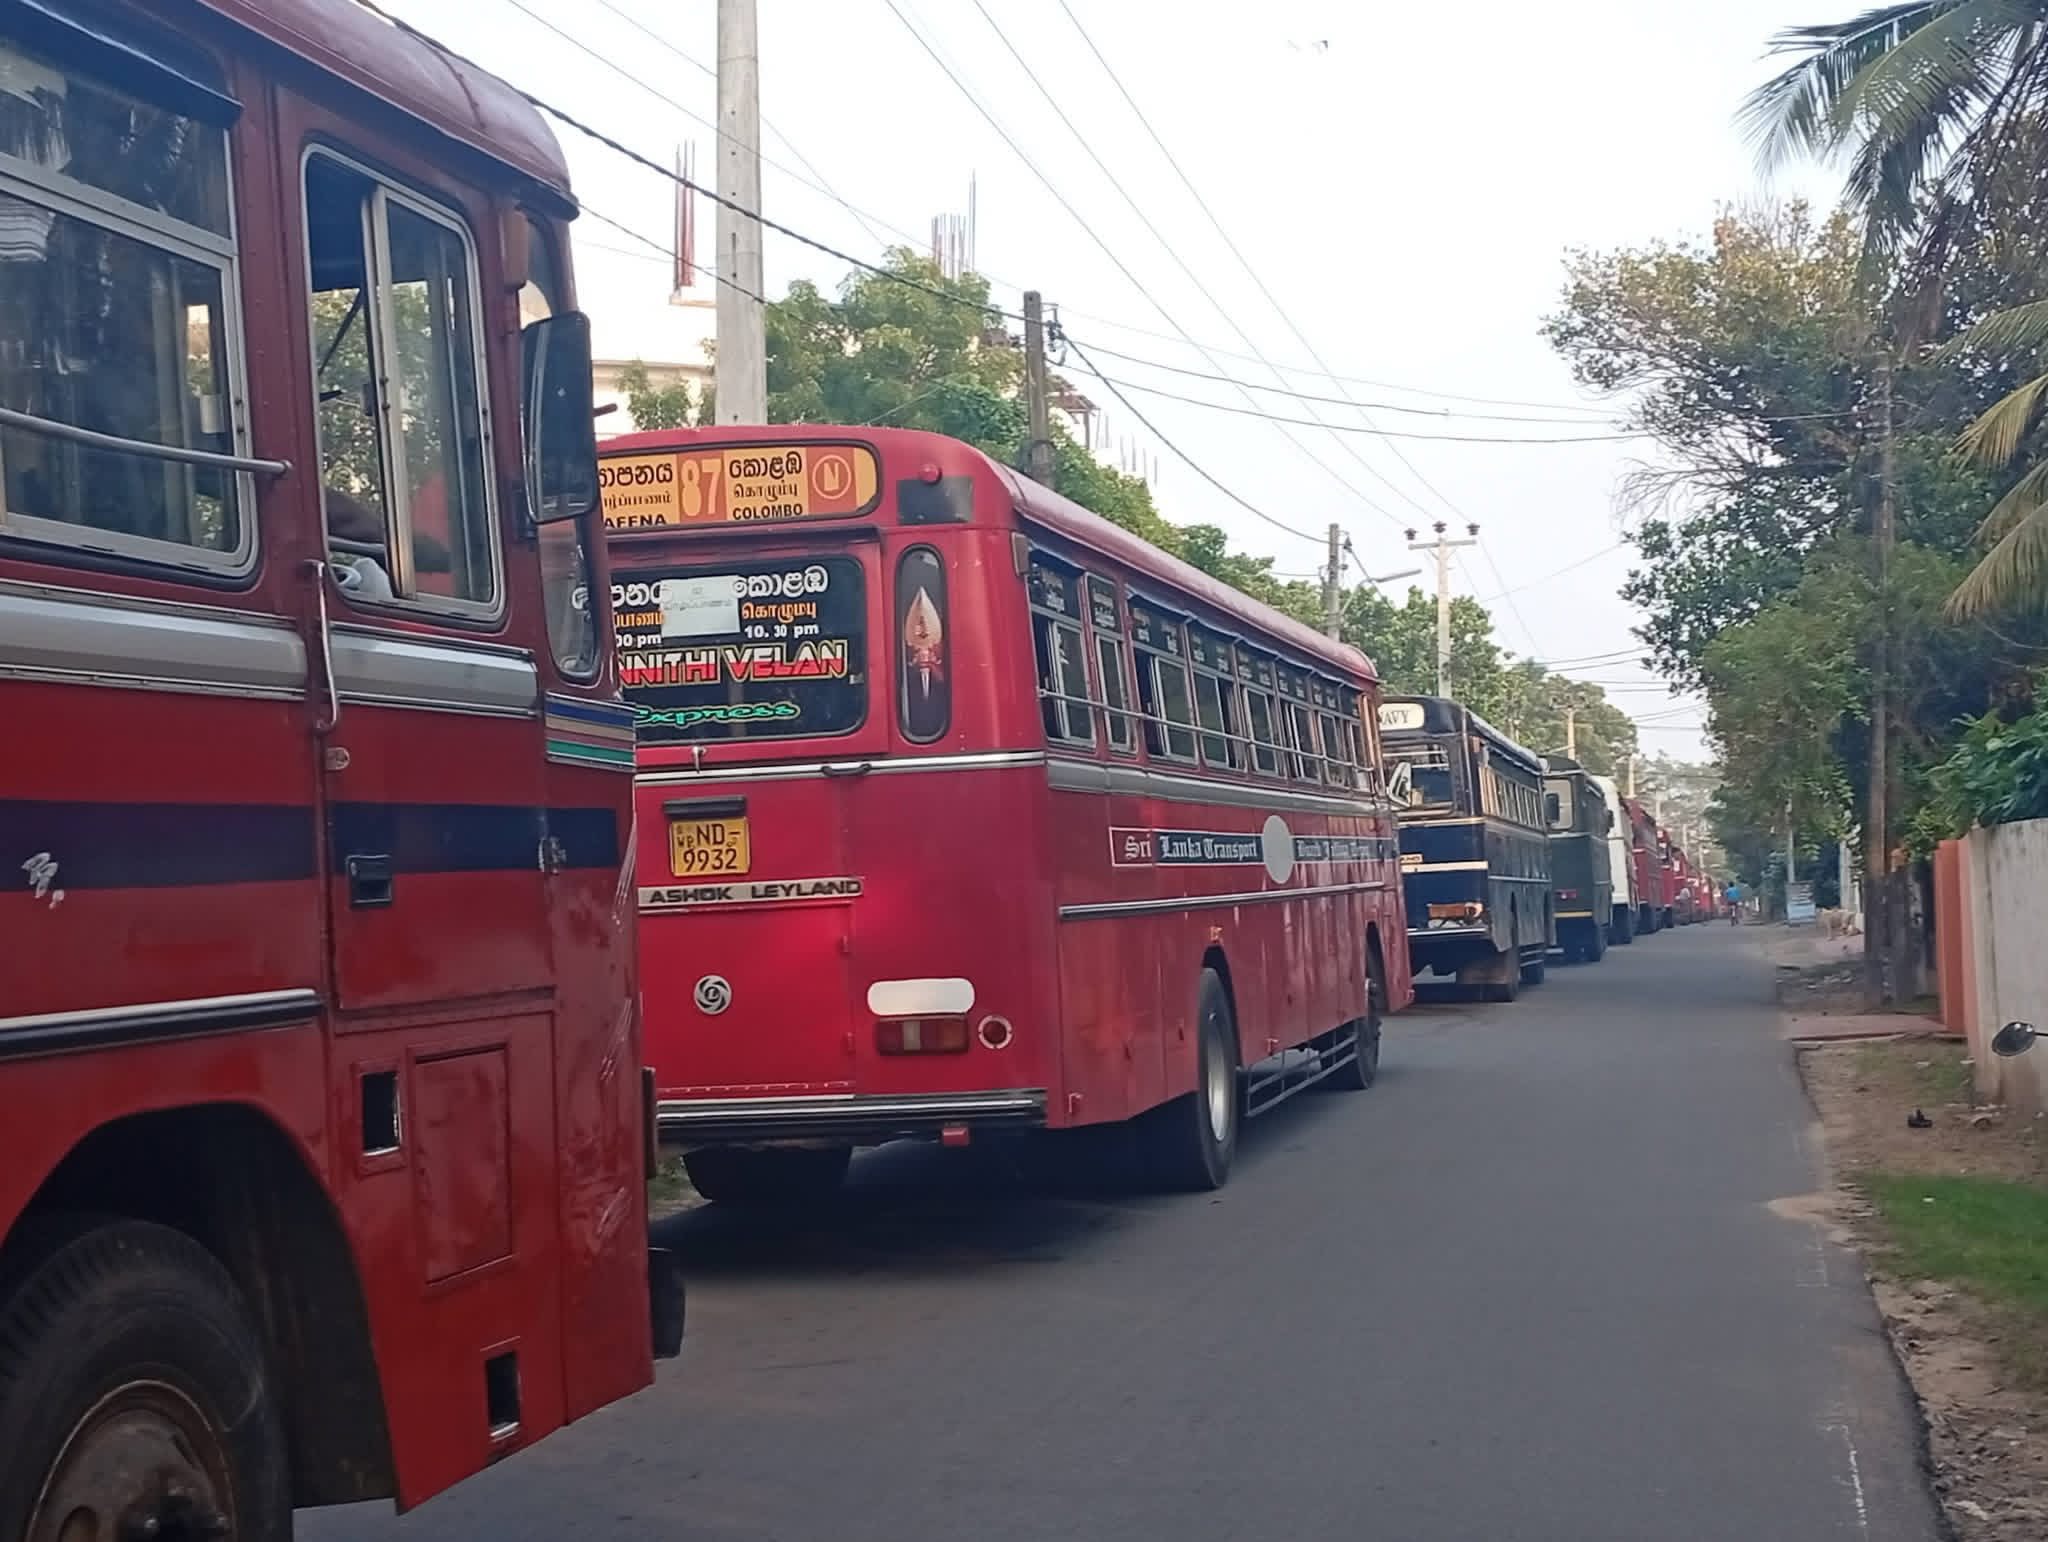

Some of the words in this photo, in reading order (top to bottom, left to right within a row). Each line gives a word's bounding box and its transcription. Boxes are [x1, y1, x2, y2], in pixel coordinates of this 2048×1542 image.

[729, 451, 803, 479] කොළඹ
[681, 457, 723, 517] 87
[732, 503, 804, 520] COLOMBO
[729, 565, 828, 598] කොළඹ
[637, 633, 662, 649] pm
[774, 624, 788, 638] 30
[794, 623, 820, 639] pm
[723, 640, 848, 682] VELAN
[683, 848, 738, 872] 9932
[1124, 834, 1152, 860] Sri
[1159, 835, 1202, 859] Lanka
[1204, 837, 1258, 861] Transport
[649, 886, 733, 904] ASHOK
[751, 880, 862, 899] LEYLAND
